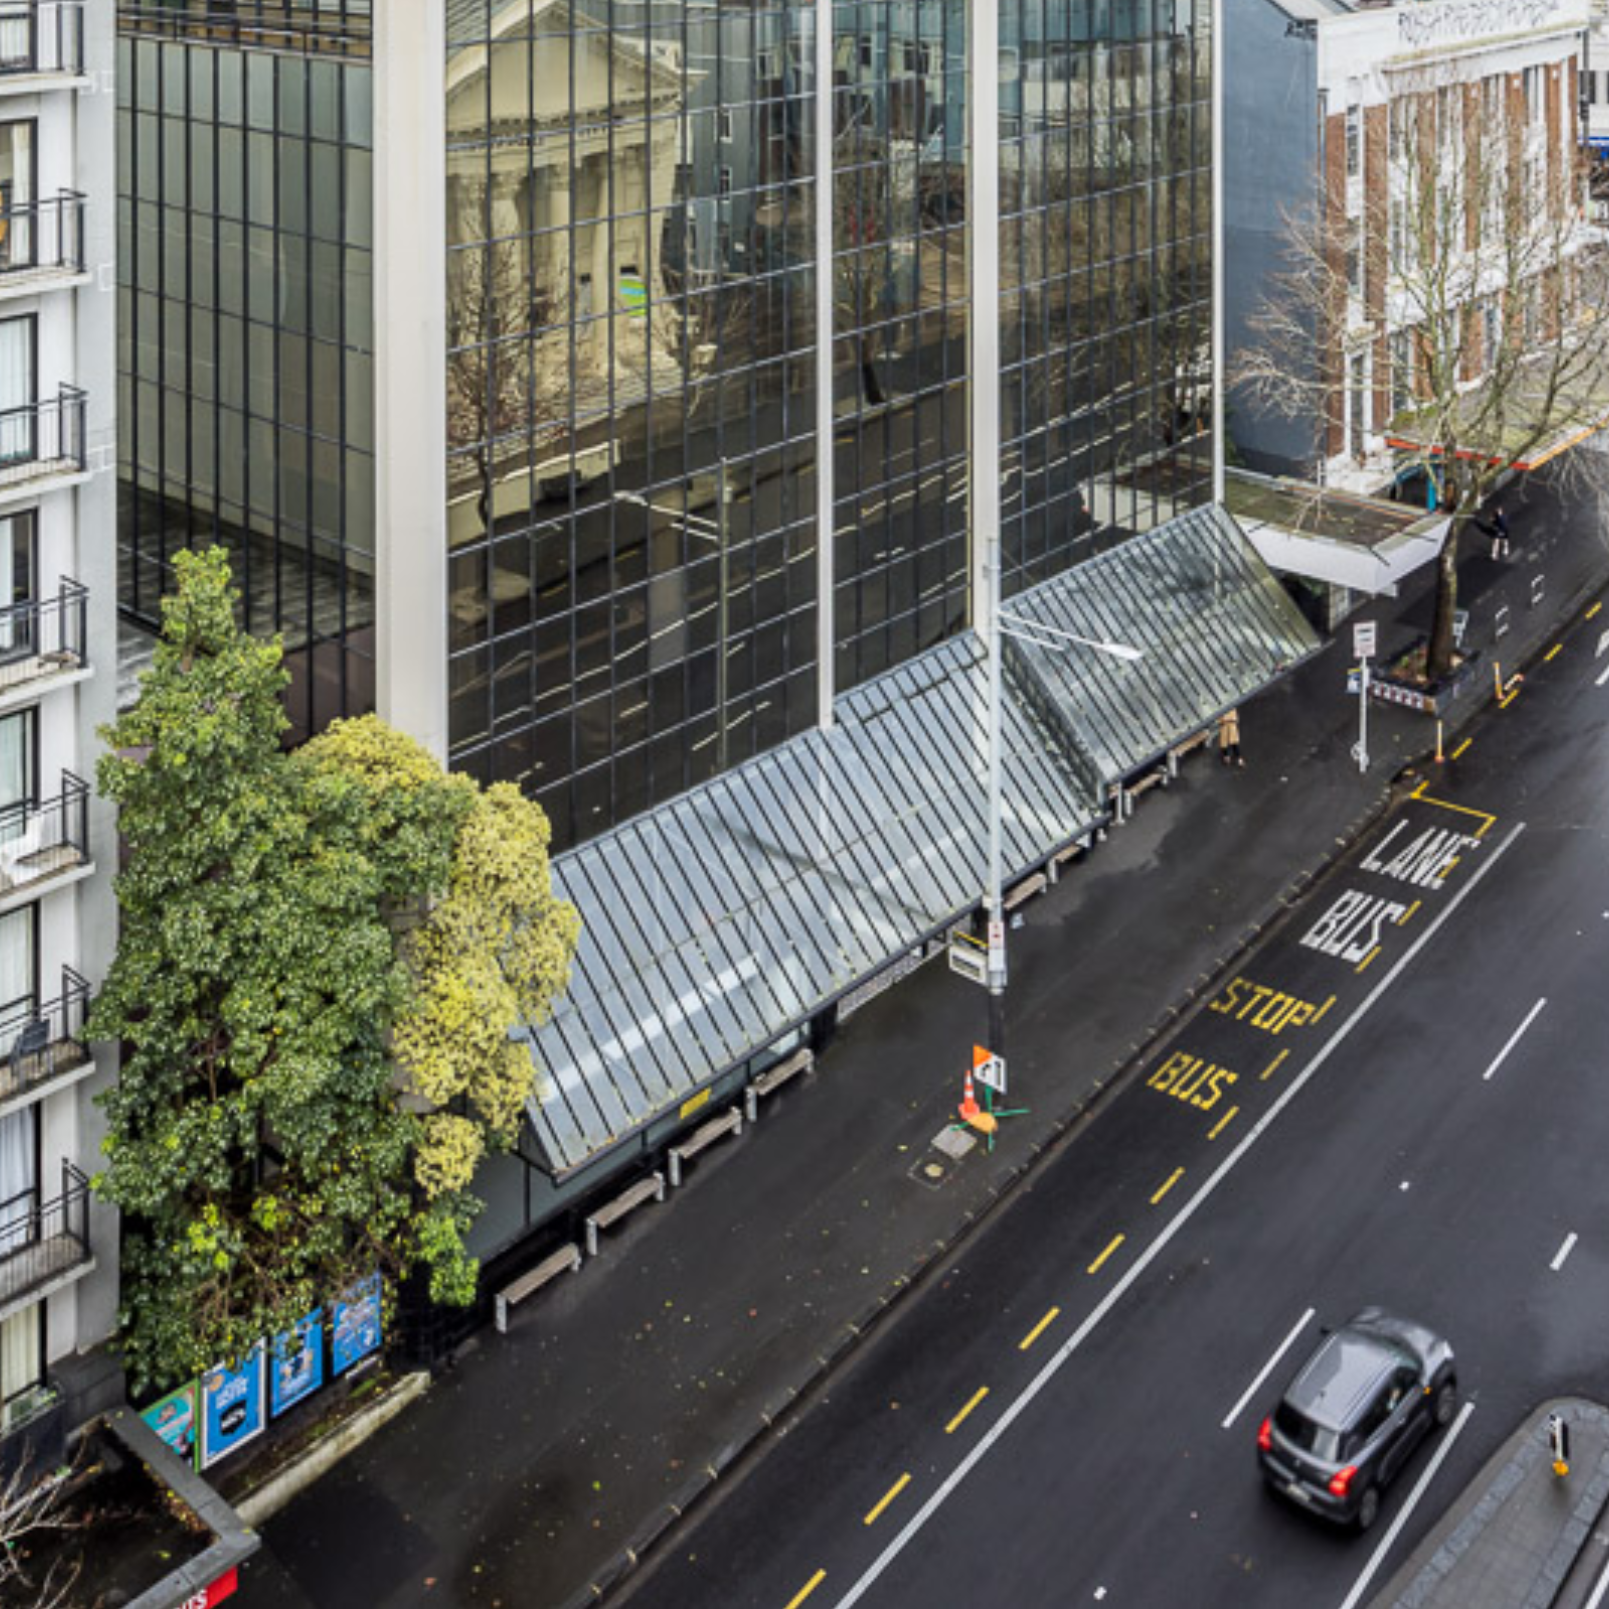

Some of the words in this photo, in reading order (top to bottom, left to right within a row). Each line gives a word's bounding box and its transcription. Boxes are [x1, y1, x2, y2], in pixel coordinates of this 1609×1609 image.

[1359, 819, 1481, 890] LANE
[1299, 889, 1406, 962] BUS
[1209, 977, 1315, 1034] STOP
[1147, 1051, 1239, 1110] BUS
